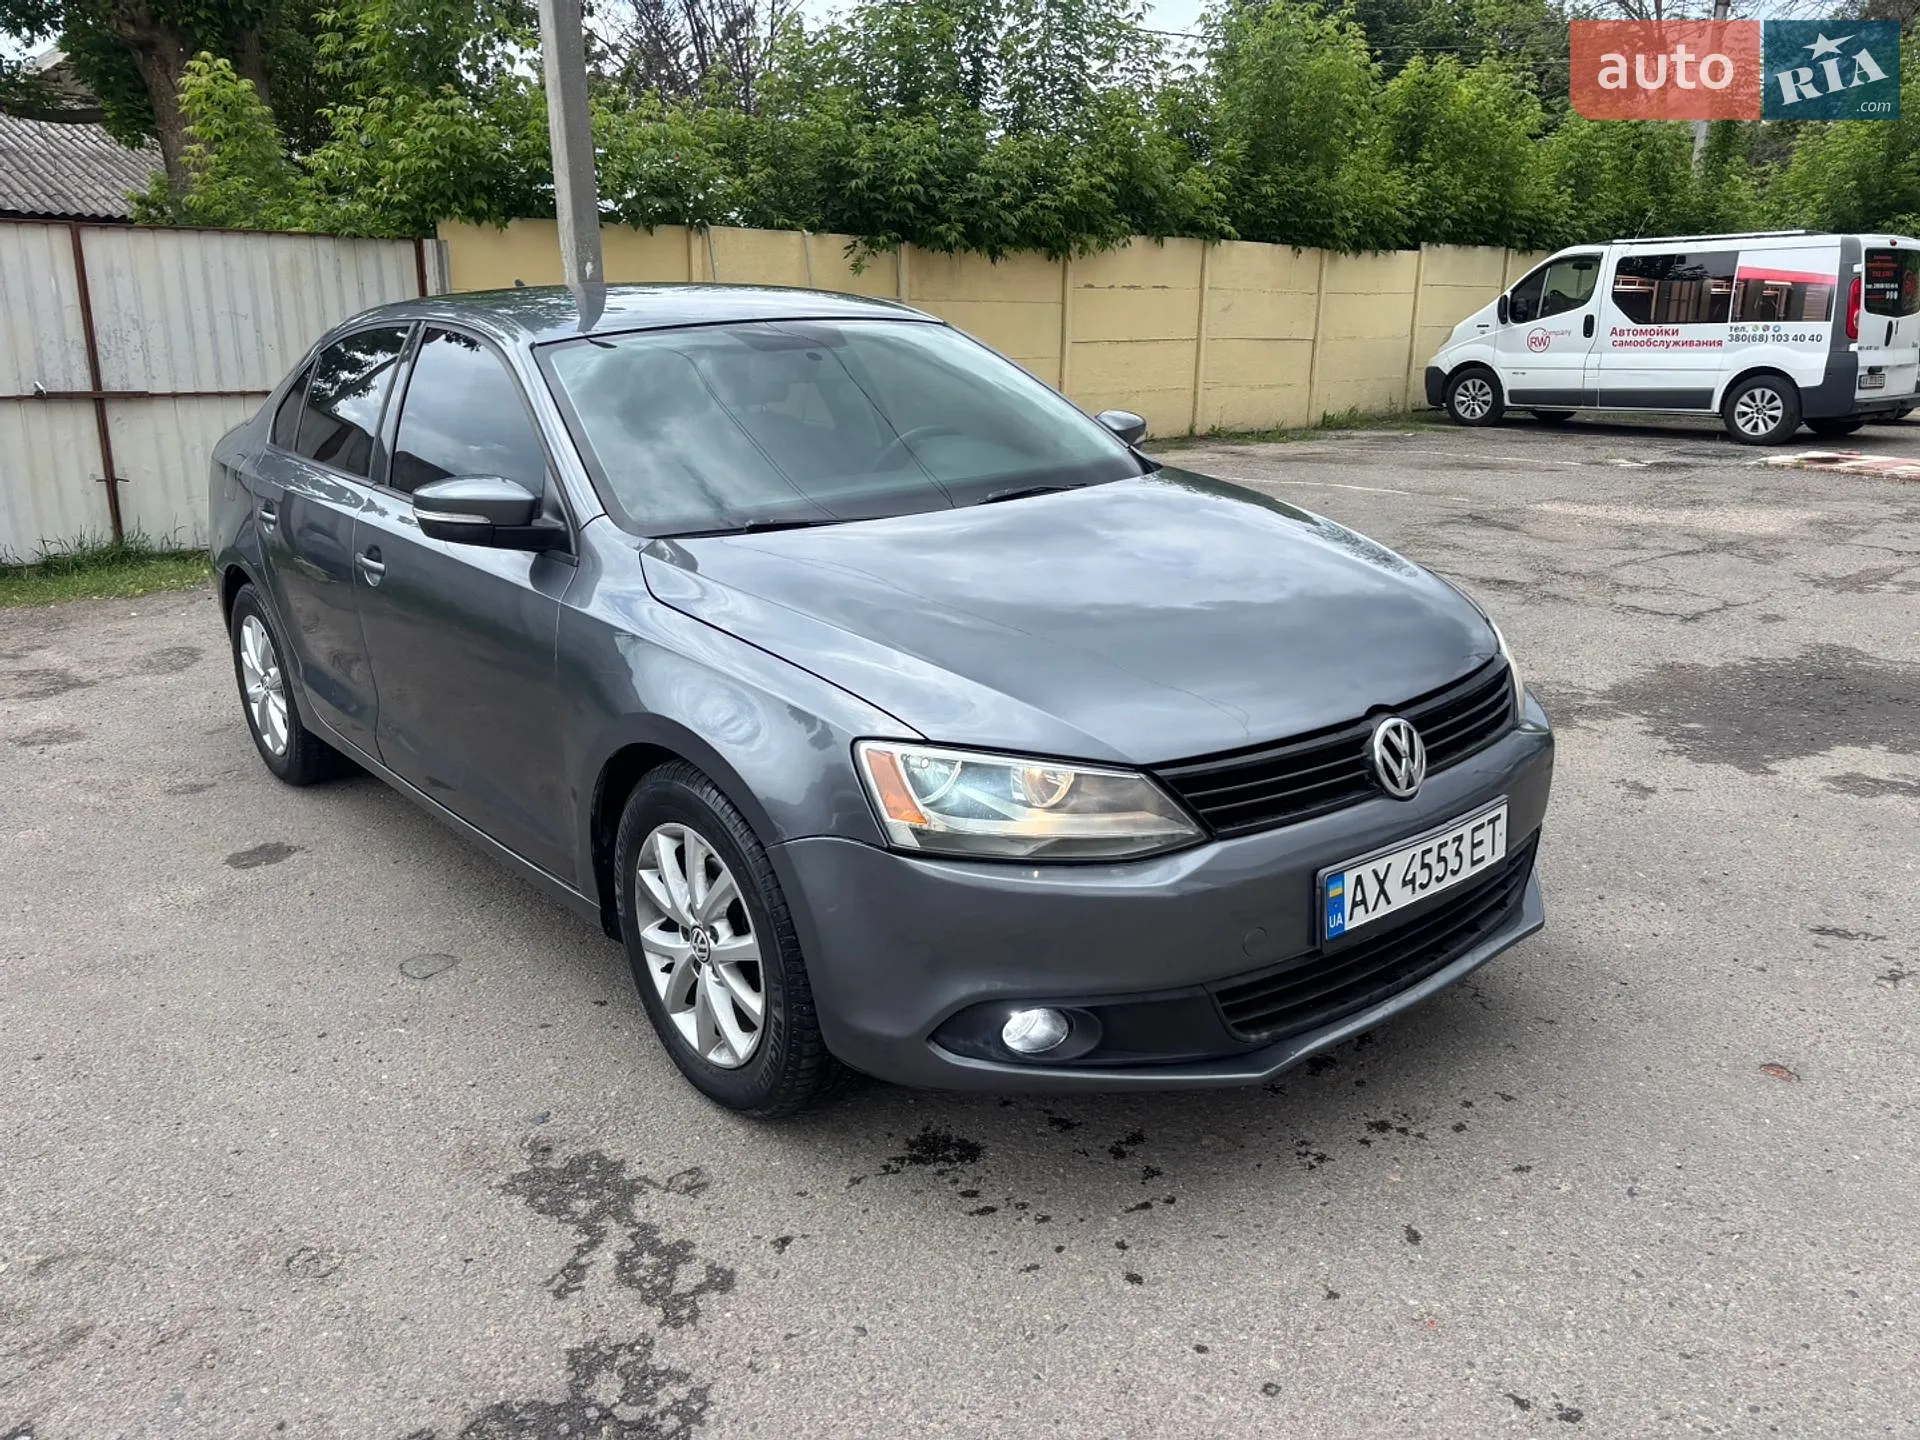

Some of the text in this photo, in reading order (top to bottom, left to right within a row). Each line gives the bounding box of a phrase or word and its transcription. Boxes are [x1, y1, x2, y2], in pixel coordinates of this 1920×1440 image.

[1610, 325, 1679, 338] Автомойки
[1728, 333, 1823, 343] 380(68) 103 40 40
[1612, 338, 1723, 349] самообслуживания
[1348, 814, 1501, 921] AX 4553 ET
[1329, 913, 1344, 929] UA
